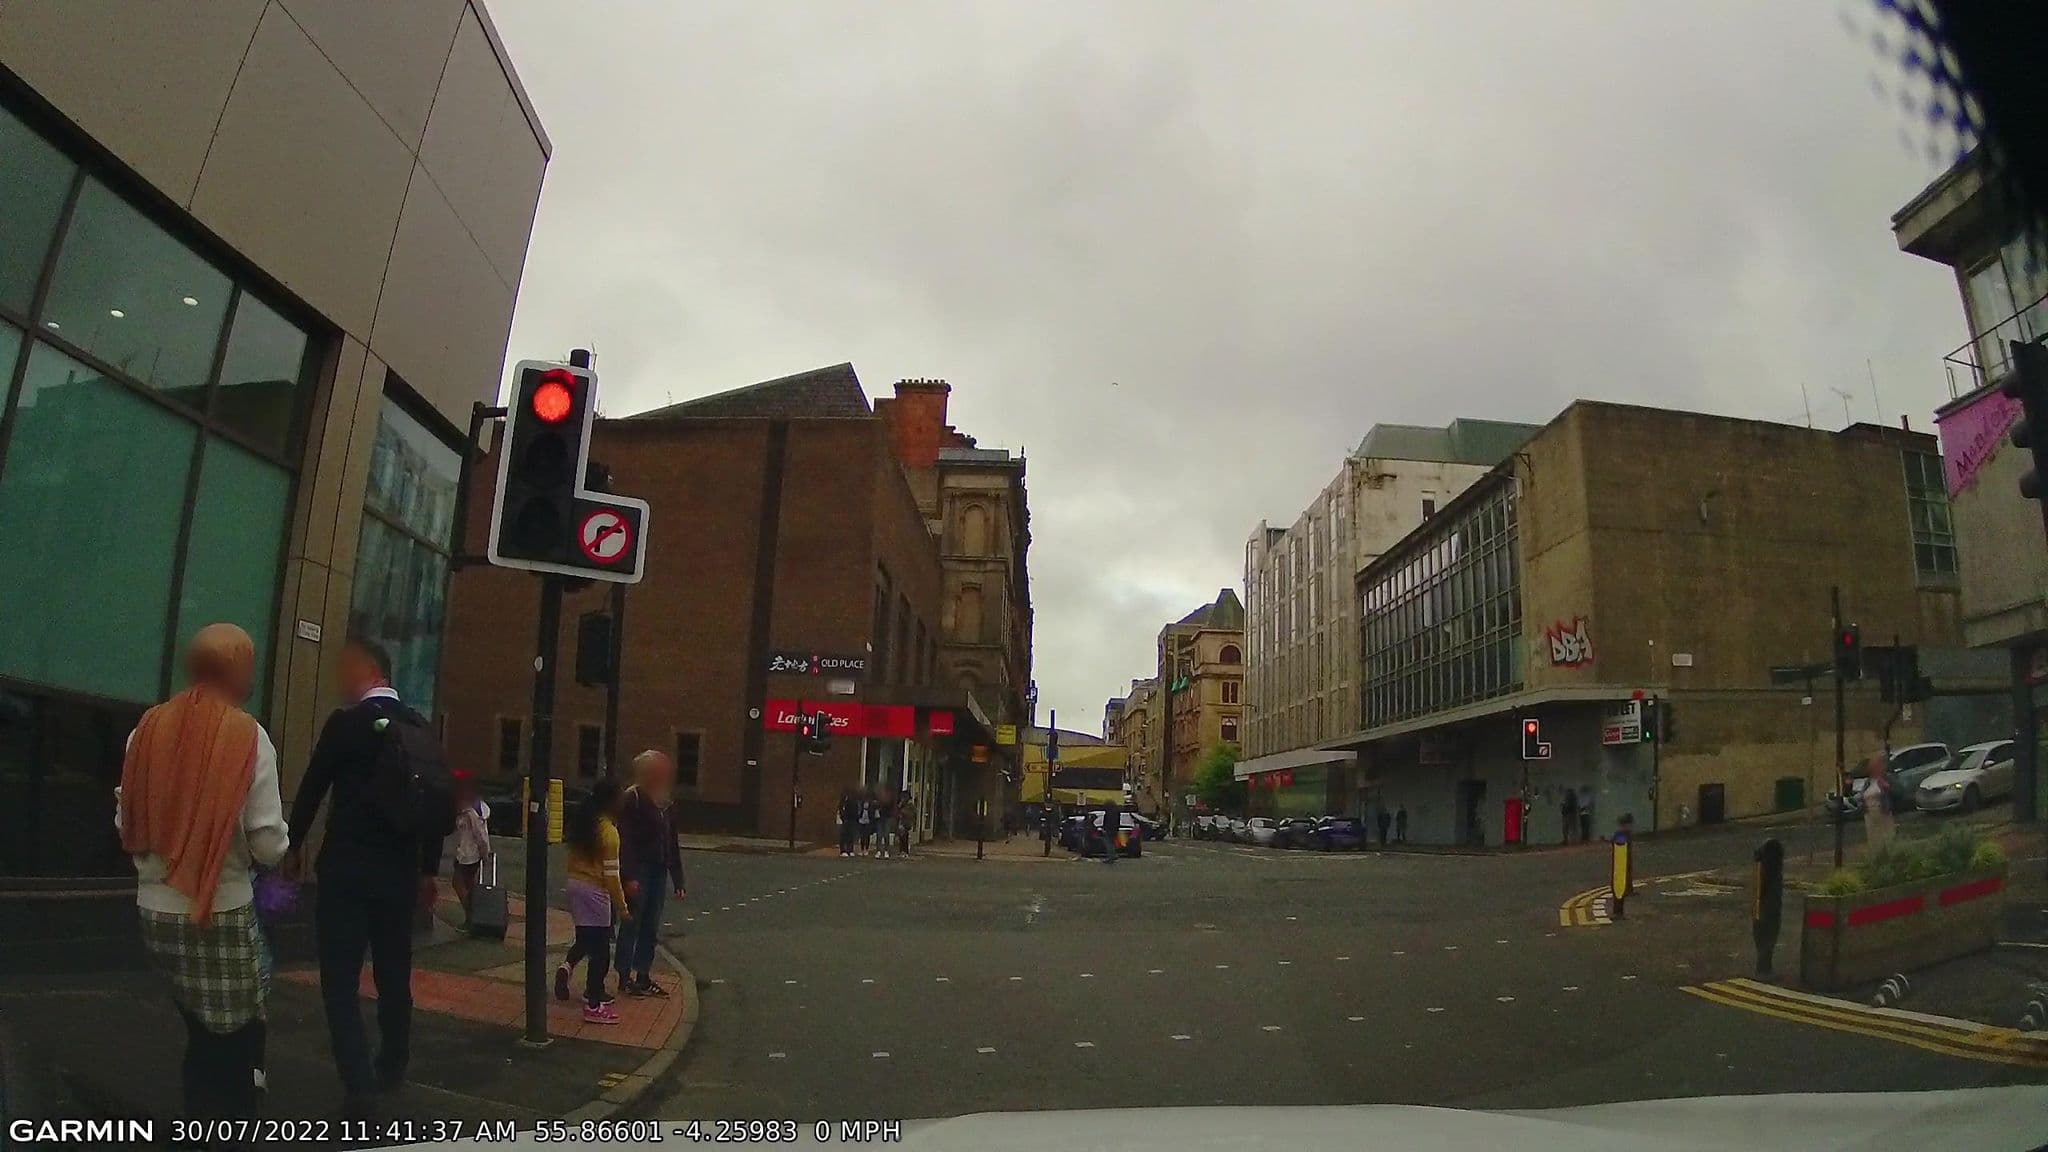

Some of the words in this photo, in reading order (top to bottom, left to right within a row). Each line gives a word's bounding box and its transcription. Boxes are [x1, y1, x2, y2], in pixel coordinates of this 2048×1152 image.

[1551, 619, 1593, 662] DBA
[821, 658, 838, 668] OLD
[839, 659, 865, 669] PLACE
